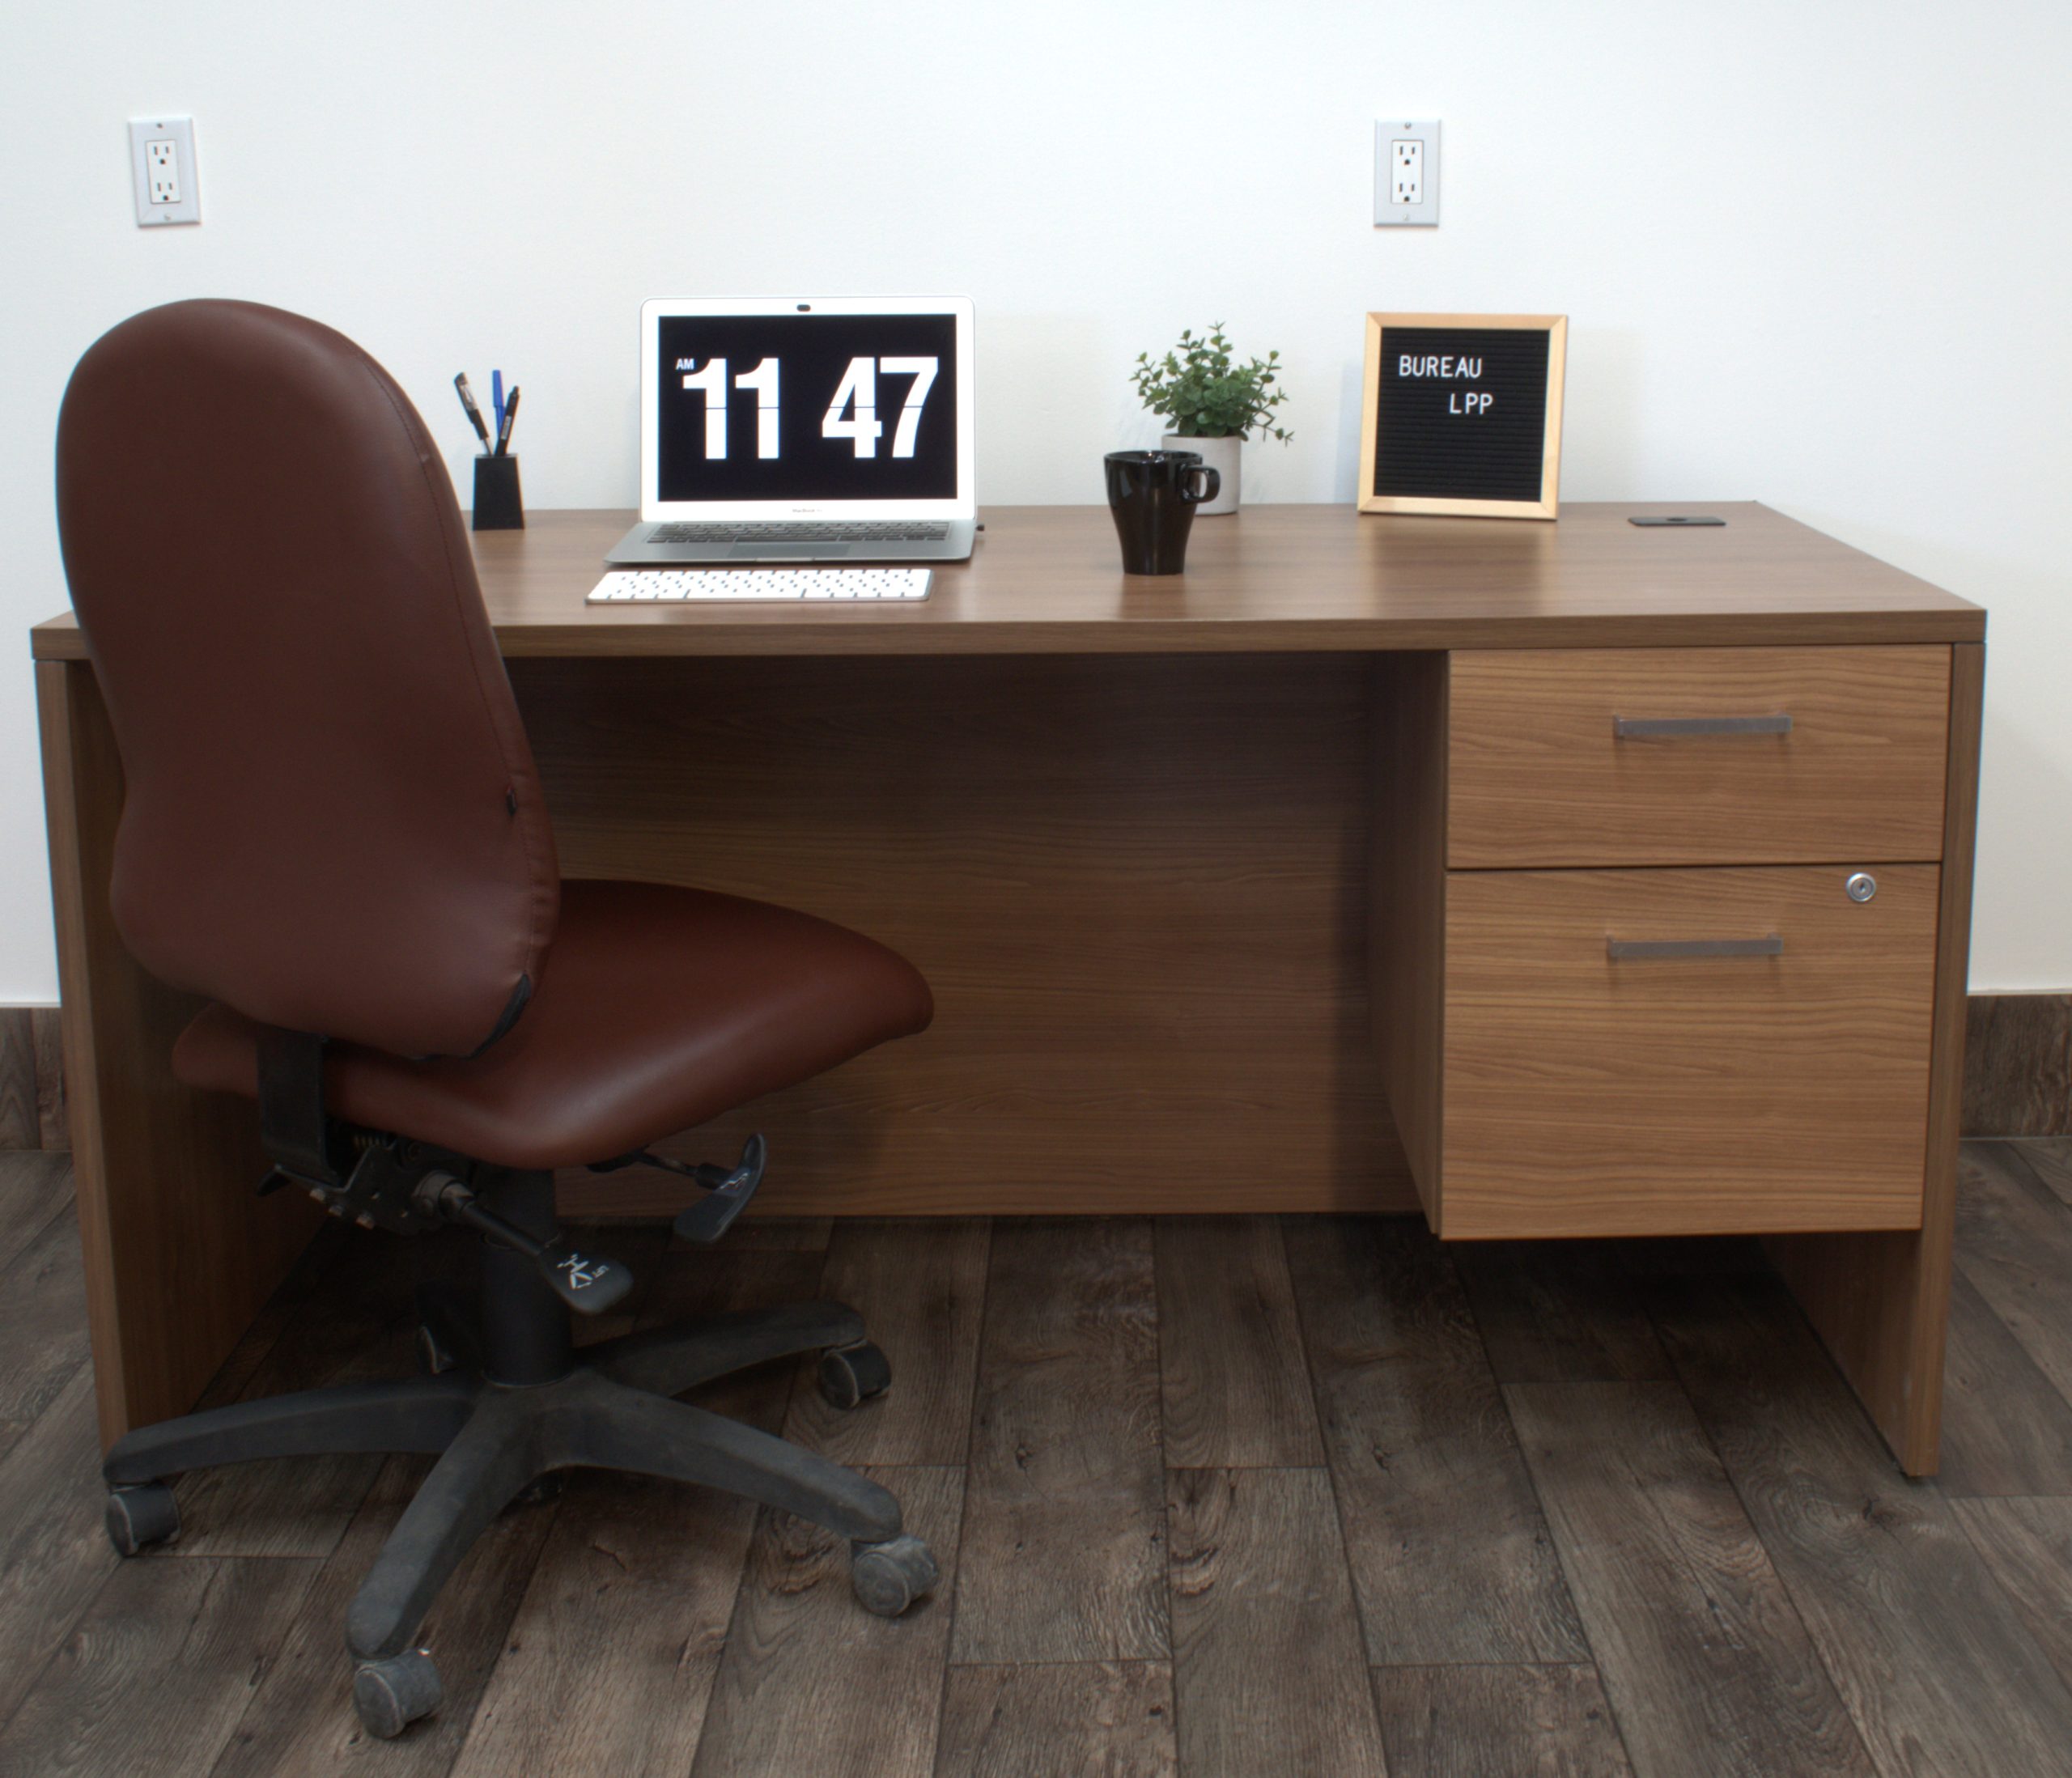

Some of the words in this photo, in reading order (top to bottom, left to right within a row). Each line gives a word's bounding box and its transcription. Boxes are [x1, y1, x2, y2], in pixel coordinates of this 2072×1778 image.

[675, 358, 695, 371] AM
[1399, 354, 1483, 379] BUREAU
[682, 358, 779, 460] 11
[822, 356, 939, 459] 47
[1450, 393, 1493, 415] LPP
